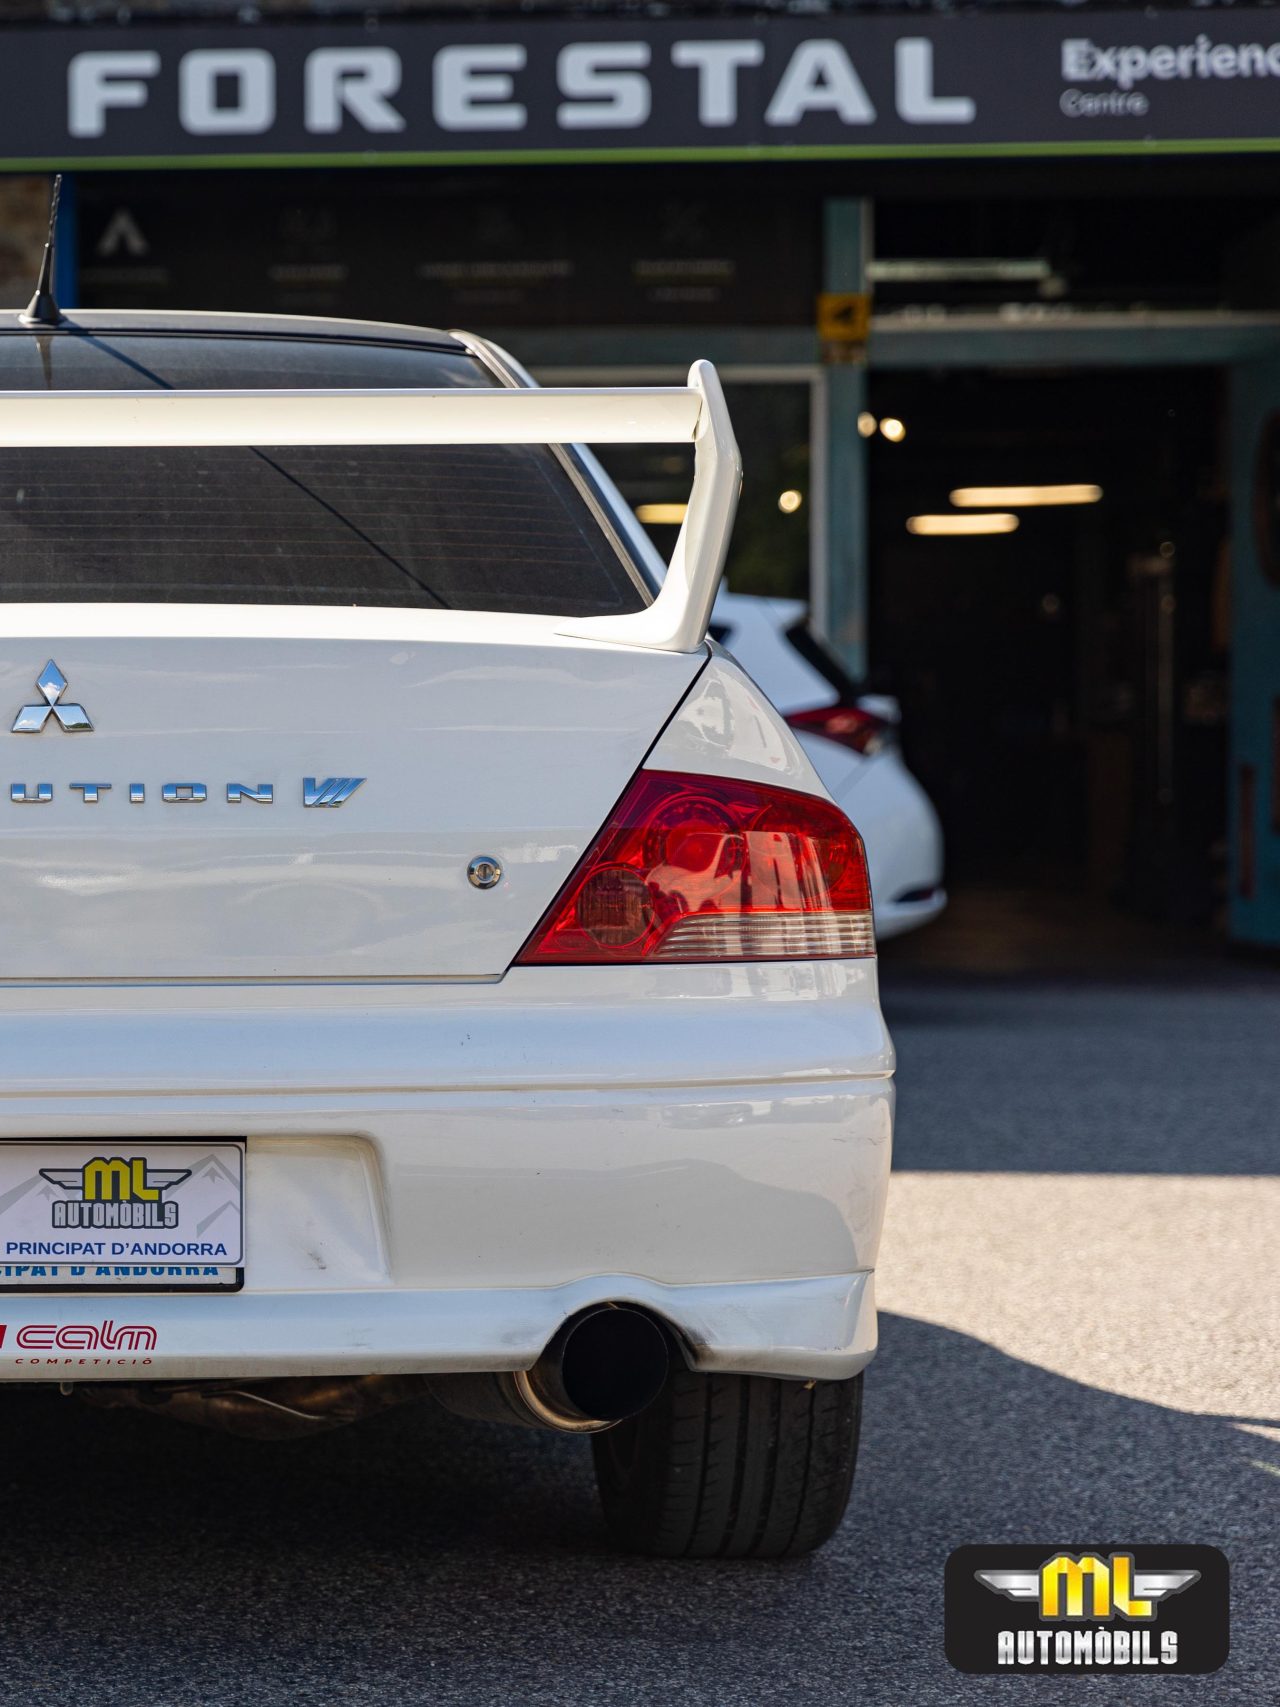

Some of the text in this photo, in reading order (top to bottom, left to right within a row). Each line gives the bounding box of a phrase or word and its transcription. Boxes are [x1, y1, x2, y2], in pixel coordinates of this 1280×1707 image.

[67, 36, 977, 138] FORESTAL
[84, 1158, 160, 1201] ML
[53, 1200, 178, 1228] AUTOMÒBILS
[5, 1241, 228, 1256] PRINCIPAT D'ANDORRA
